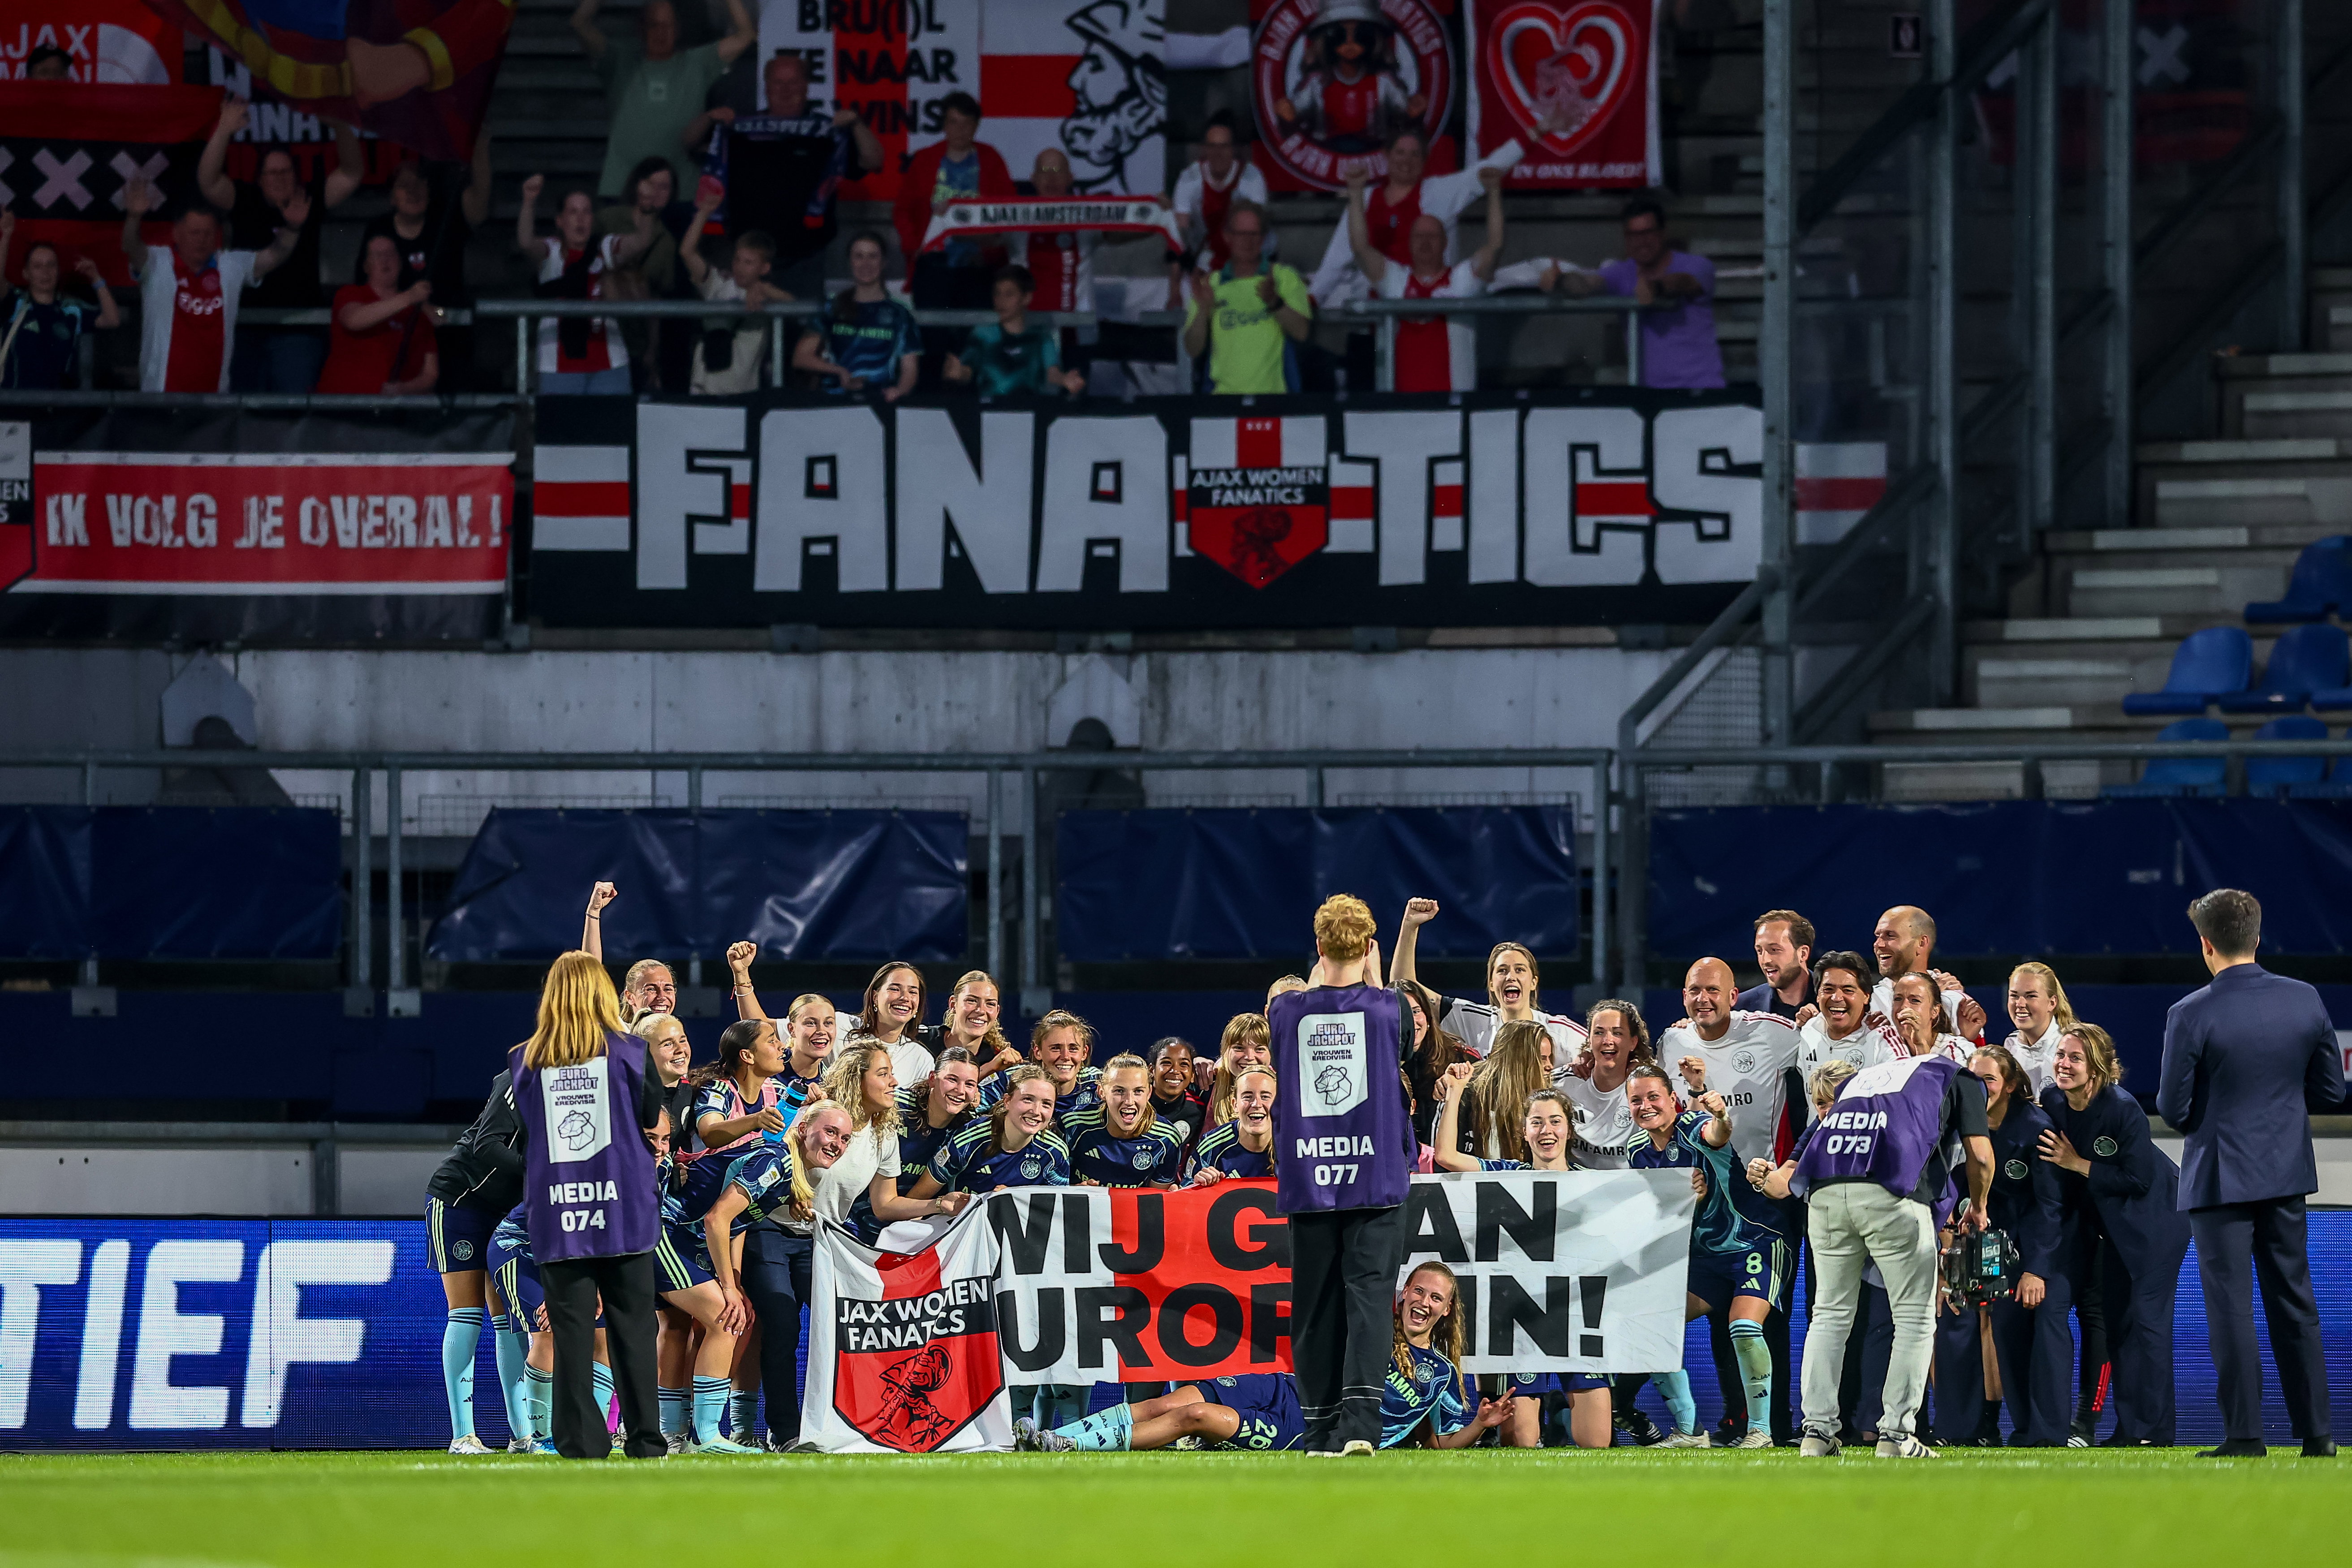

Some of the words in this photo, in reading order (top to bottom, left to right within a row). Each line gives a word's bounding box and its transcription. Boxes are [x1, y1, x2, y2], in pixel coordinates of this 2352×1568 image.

[0, 22, 92, 60] JAX
[838, 49, 959, 84] NAAR
[1192, 469, 1244, 487] AJAX
[1246, 468, 1324, 487] WOMEN
[1210, 487, 1305, 507] FANATICS
[46, 493, 90, 547] IK
[105, 493, 218, 548] VOLG
[233, 495, 285, 548] JE
[1308, 1033, 1356, 1047] JACKPOT
[1316, 1024, 1345, 1035] EURO
[550, 1077, 598, 1092] JACKPOT
[559, 1068, 589, 1080] EURO
[1817, 1110, 1887, 1130] MEDIA
[1296, 1135, 1375, 1159] MEDIA
[1826, 1134, 1871, 1155] 073
[1314, 1163, 1359, 1186] 077
[549, 1180, 618, 1205] MEDIA
[560, 1209, 606, 1233] 074
[987, 1193, 1164, 1277] WIJ
[1746, 1252, 1763, 1274] 8
[840, 1299, 890, 1324] JAX
[848, 1309, 966, 1350] FANATCS
[1249, 1418, 1278, 1448] 26
